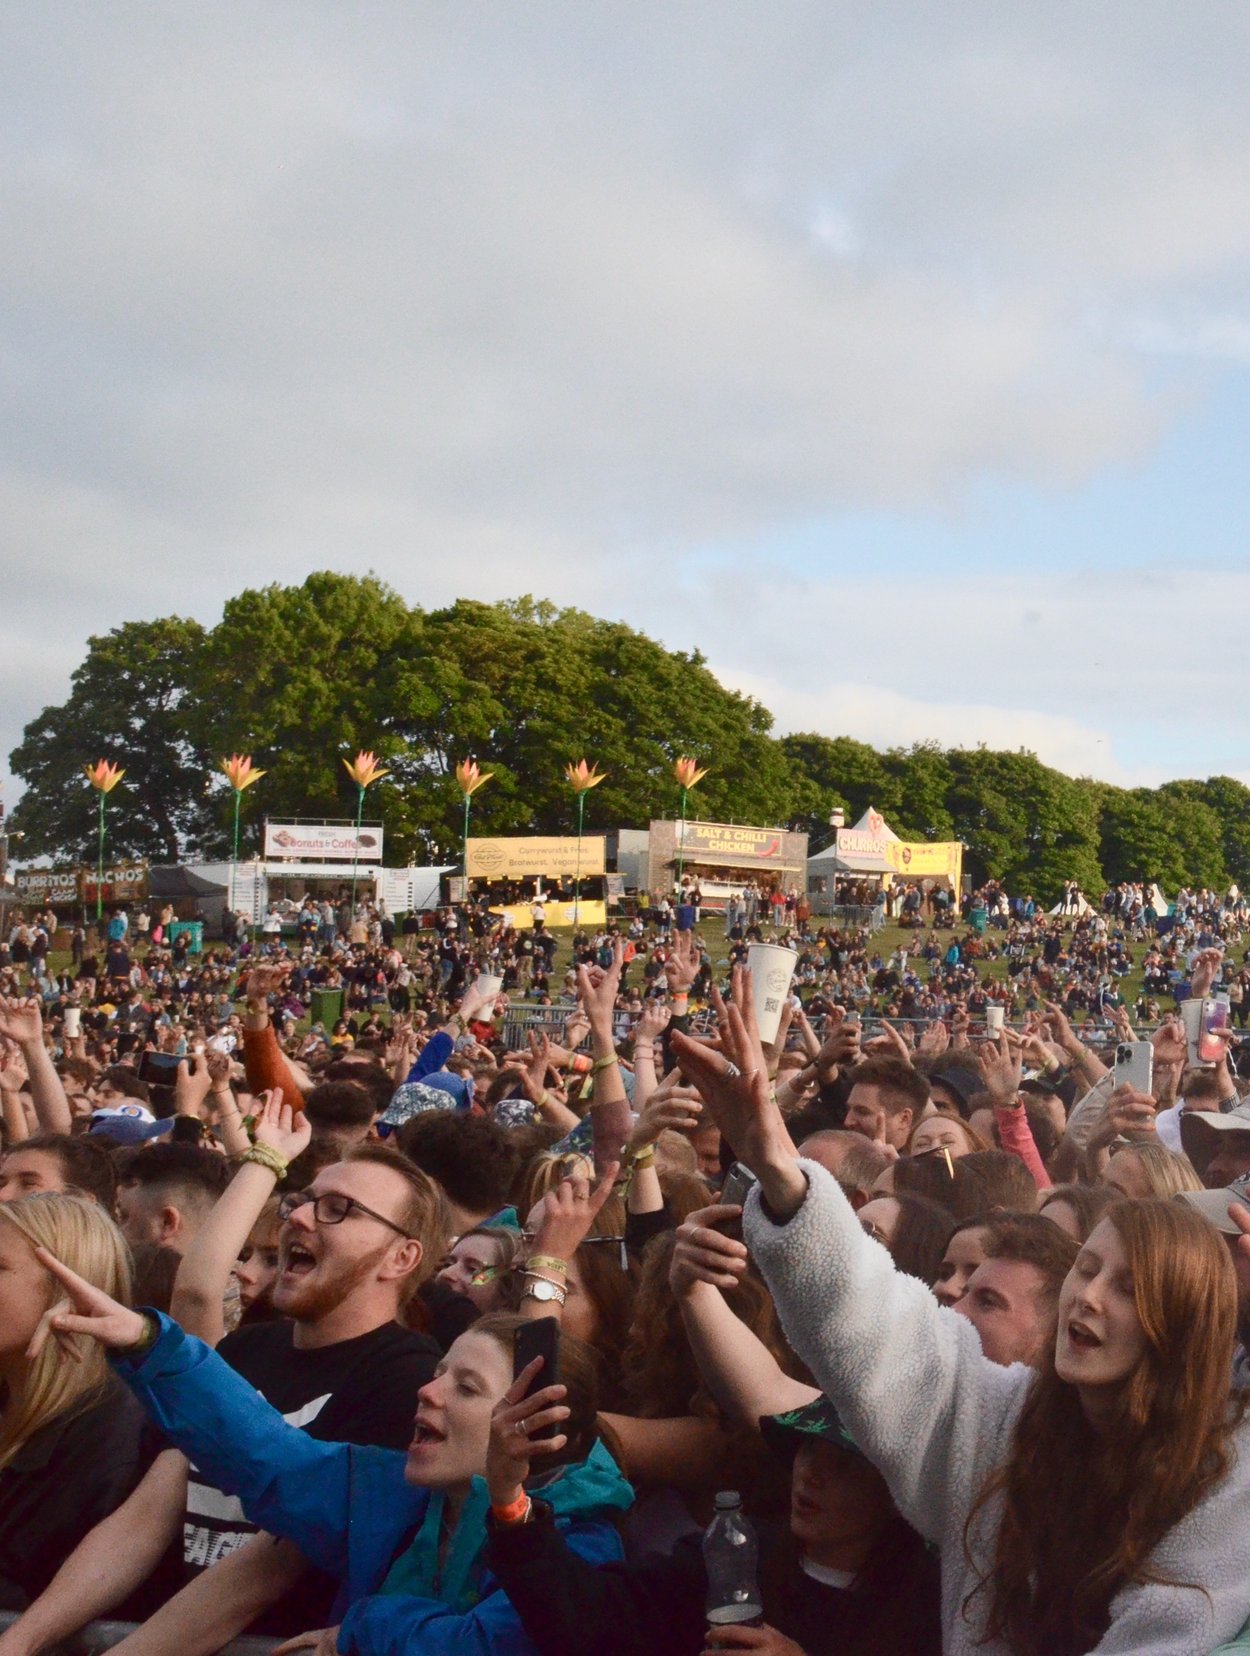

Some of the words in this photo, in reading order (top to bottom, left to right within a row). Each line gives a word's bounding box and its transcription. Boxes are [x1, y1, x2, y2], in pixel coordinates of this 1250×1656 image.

[697, 828, 721, 838] SALT
[724, 830, 732, 839] &
[734, 831, 766, 842] CHILLI
[709, 840, 755, 852] CHICKEN
[840, 838, 888, 853] CHURROS
